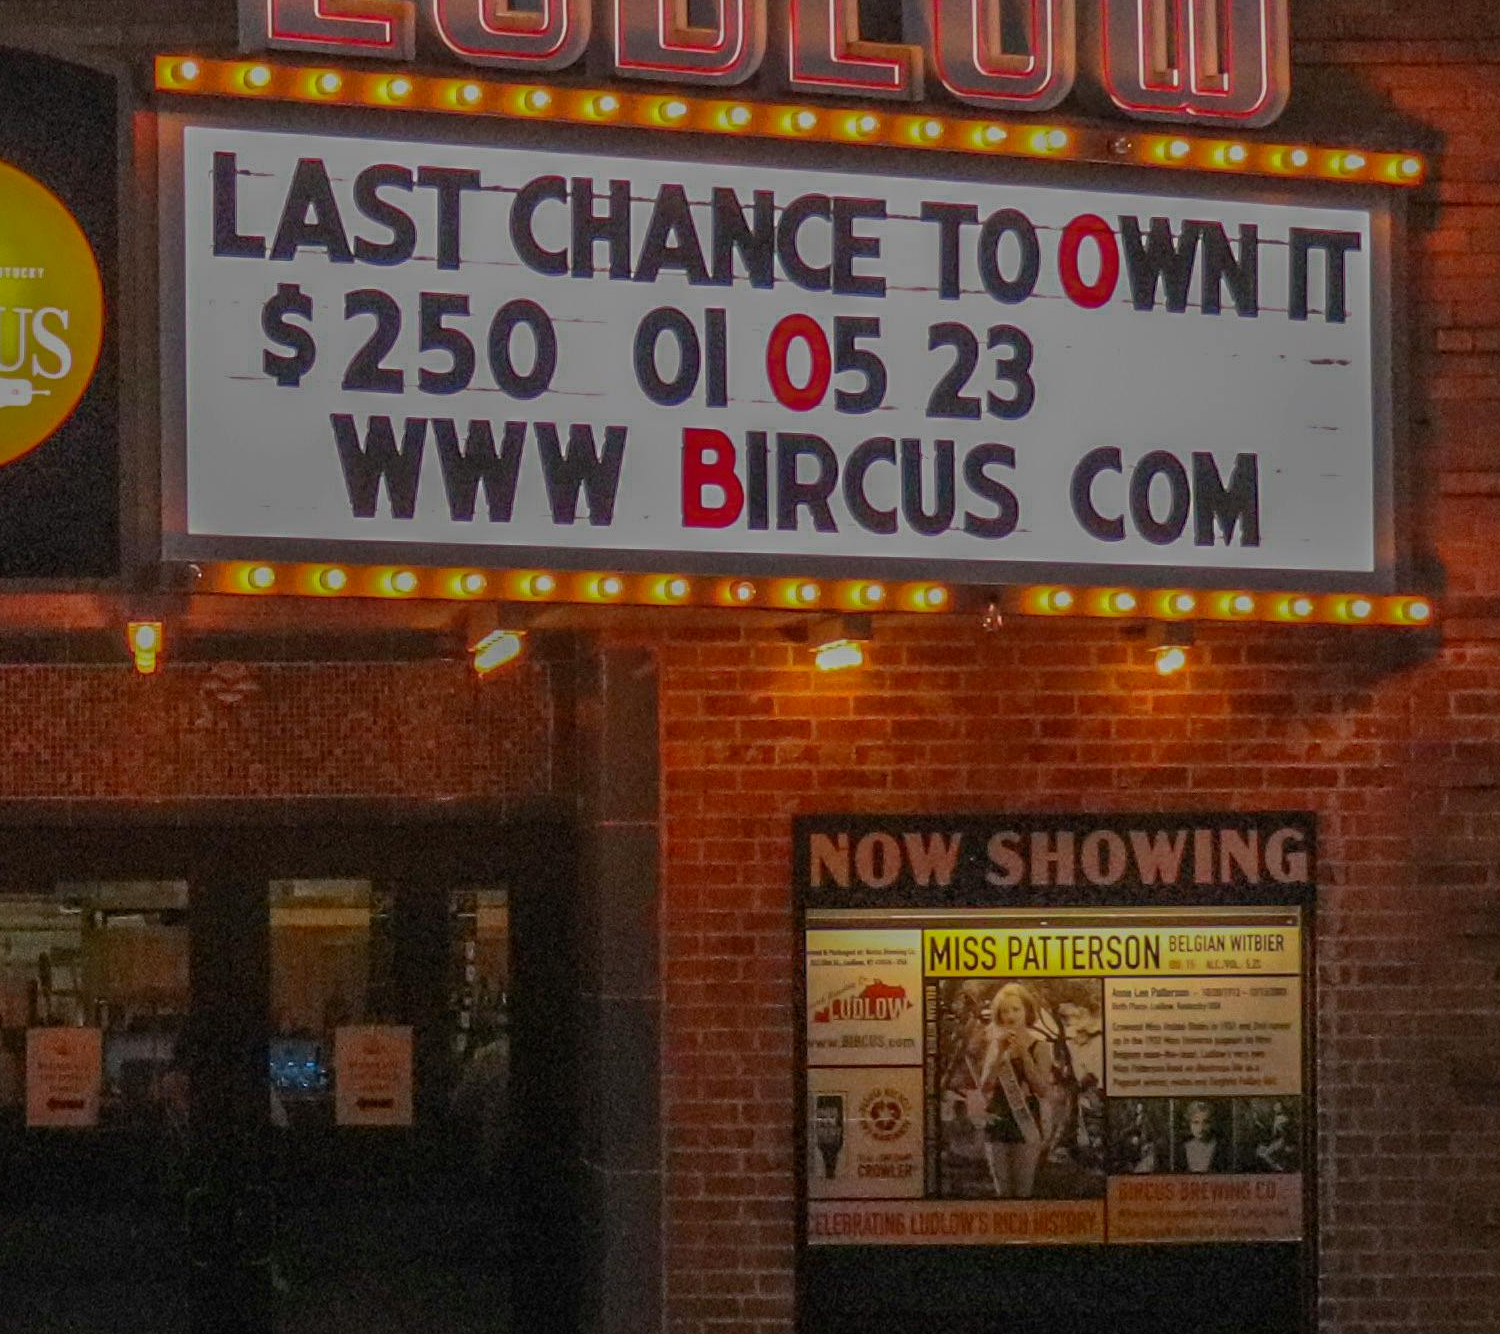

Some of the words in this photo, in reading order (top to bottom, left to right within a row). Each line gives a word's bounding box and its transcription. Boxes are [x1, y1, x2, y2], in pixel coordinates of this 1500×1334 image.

[213, 152, 480, 271] LAST
[509, 175, 887, 299] CHANCE
[921, 200, 1041, 305] TO
[1058, 214, 1259, 317] OWN
[1288, 225, 1362, 324] IT
[262, 283, 557, 400] $250
[926, 322, 1036, 421] 23
[330, 413, 628, 526] WWW
[681, 427, 1020, 538] BIRCUS
[1070, 445, 1262, 547] COM
[809, 831, 962, 888] NOW
[986, 827, 1310, 886] SHOWING
[930, 936, 997, 971] MISS
[1008, 935, 1160, 970] PATTERSON
[1168, 934, 1225, 952] BELGIAN
[1229, 933, 1285, 952] WITBIER
[830, 996, 908, 1021] LUDLOW
